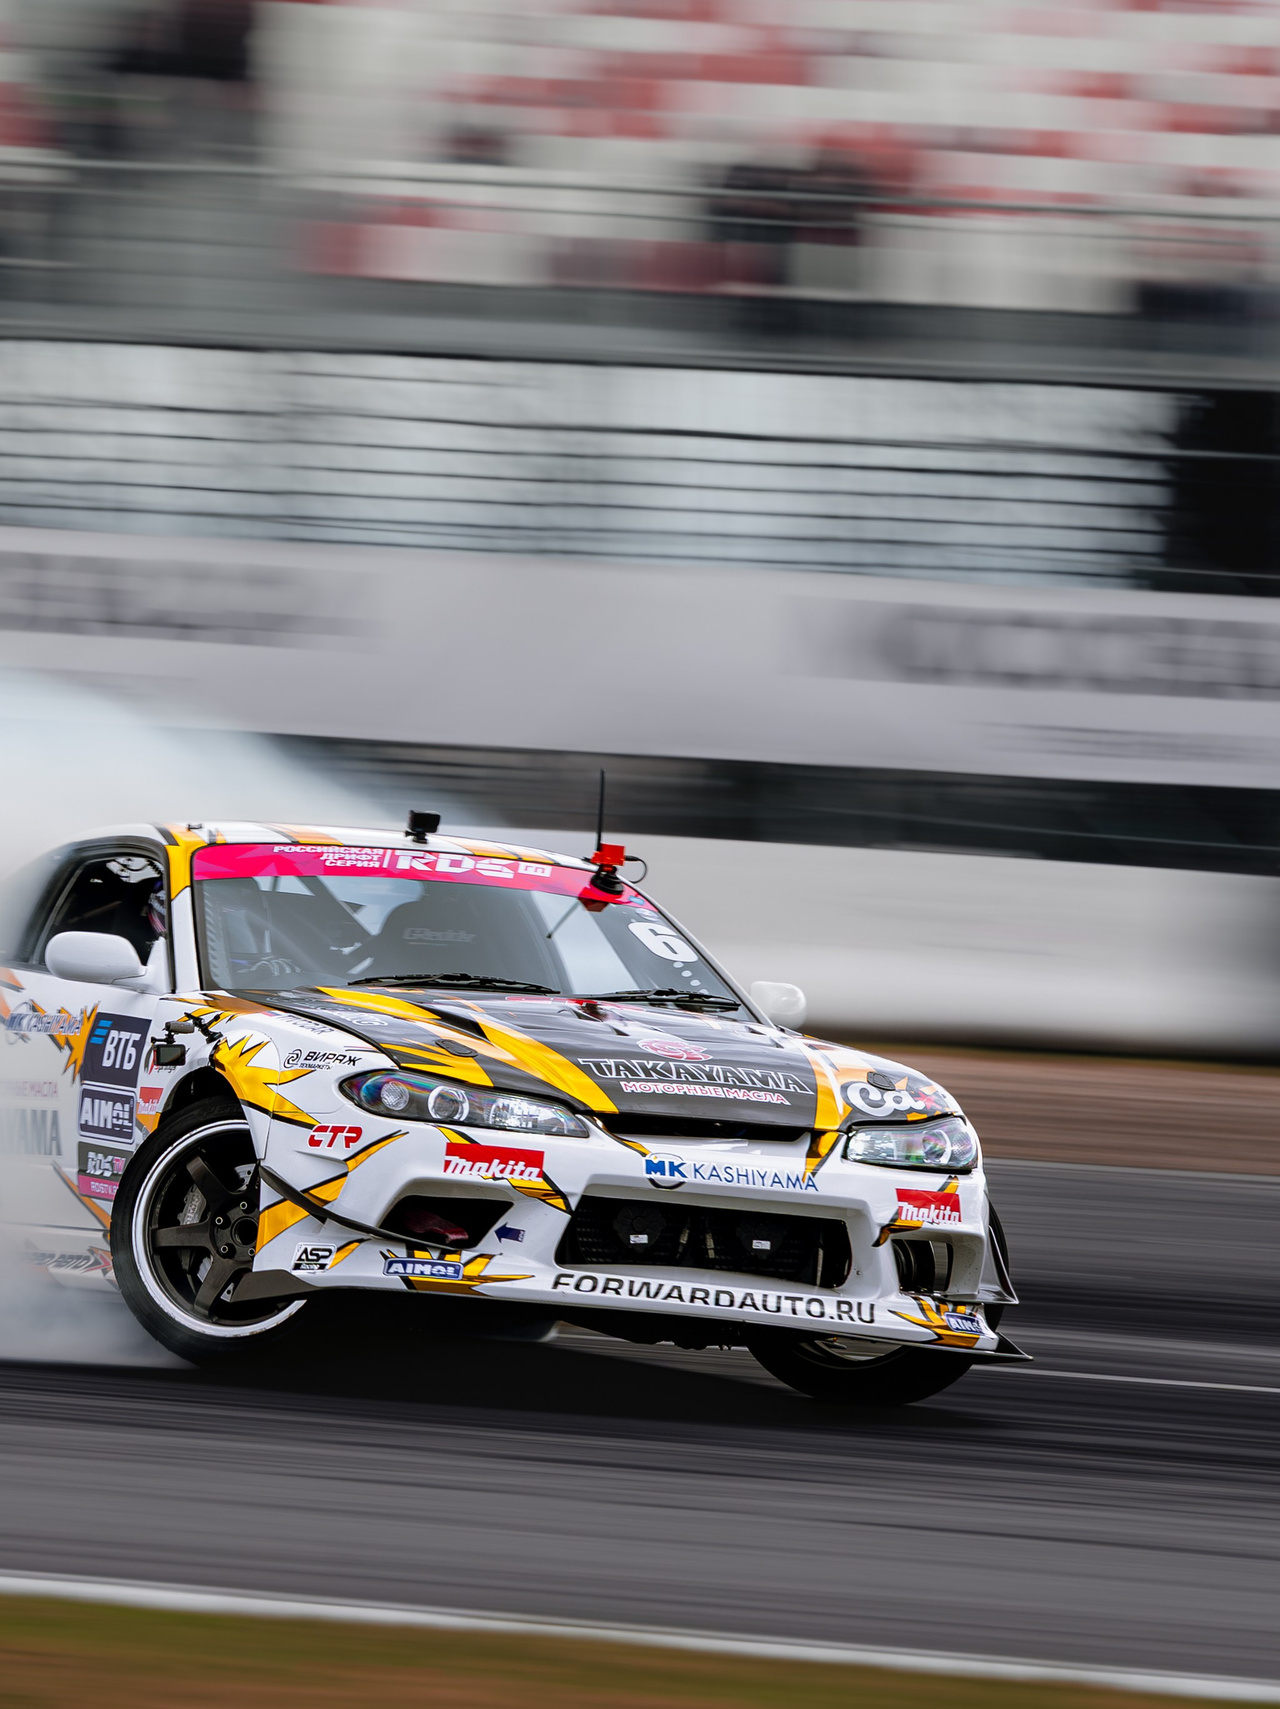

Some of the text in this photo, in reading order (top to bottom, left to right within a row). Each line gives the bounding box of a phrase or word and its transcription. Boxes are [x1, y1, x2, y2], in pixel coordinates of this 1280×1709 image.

[273, 846, 384, 855] РОССИЙСКАЯ
[320, 853, 382, 861] ДРИФТ
[325, 860, 380, 868] СЕРИЯ
[395, 851, 515, 879] RDS
[627, 922, 699, 962] 6
[102, 1030, 141, 1071] ВТБ
[304, 1051, 362, 1066] ВИРАЖ
[577, 1058, 815, 1095] TAKAYAMA
[622, 1081, 791, 1105] МОТОРНЫЕ МАСЛА
[80, 1097, 132, 1132] AIMOL
[646, 1159, 819, 1192] MK KASHIYAMA
[296, 1247, 333, 1262] ASP
[388, 1262, 458, 1277] AIMOL
[551, 1273, 876, 1324] FORWARDAUTO.RU
